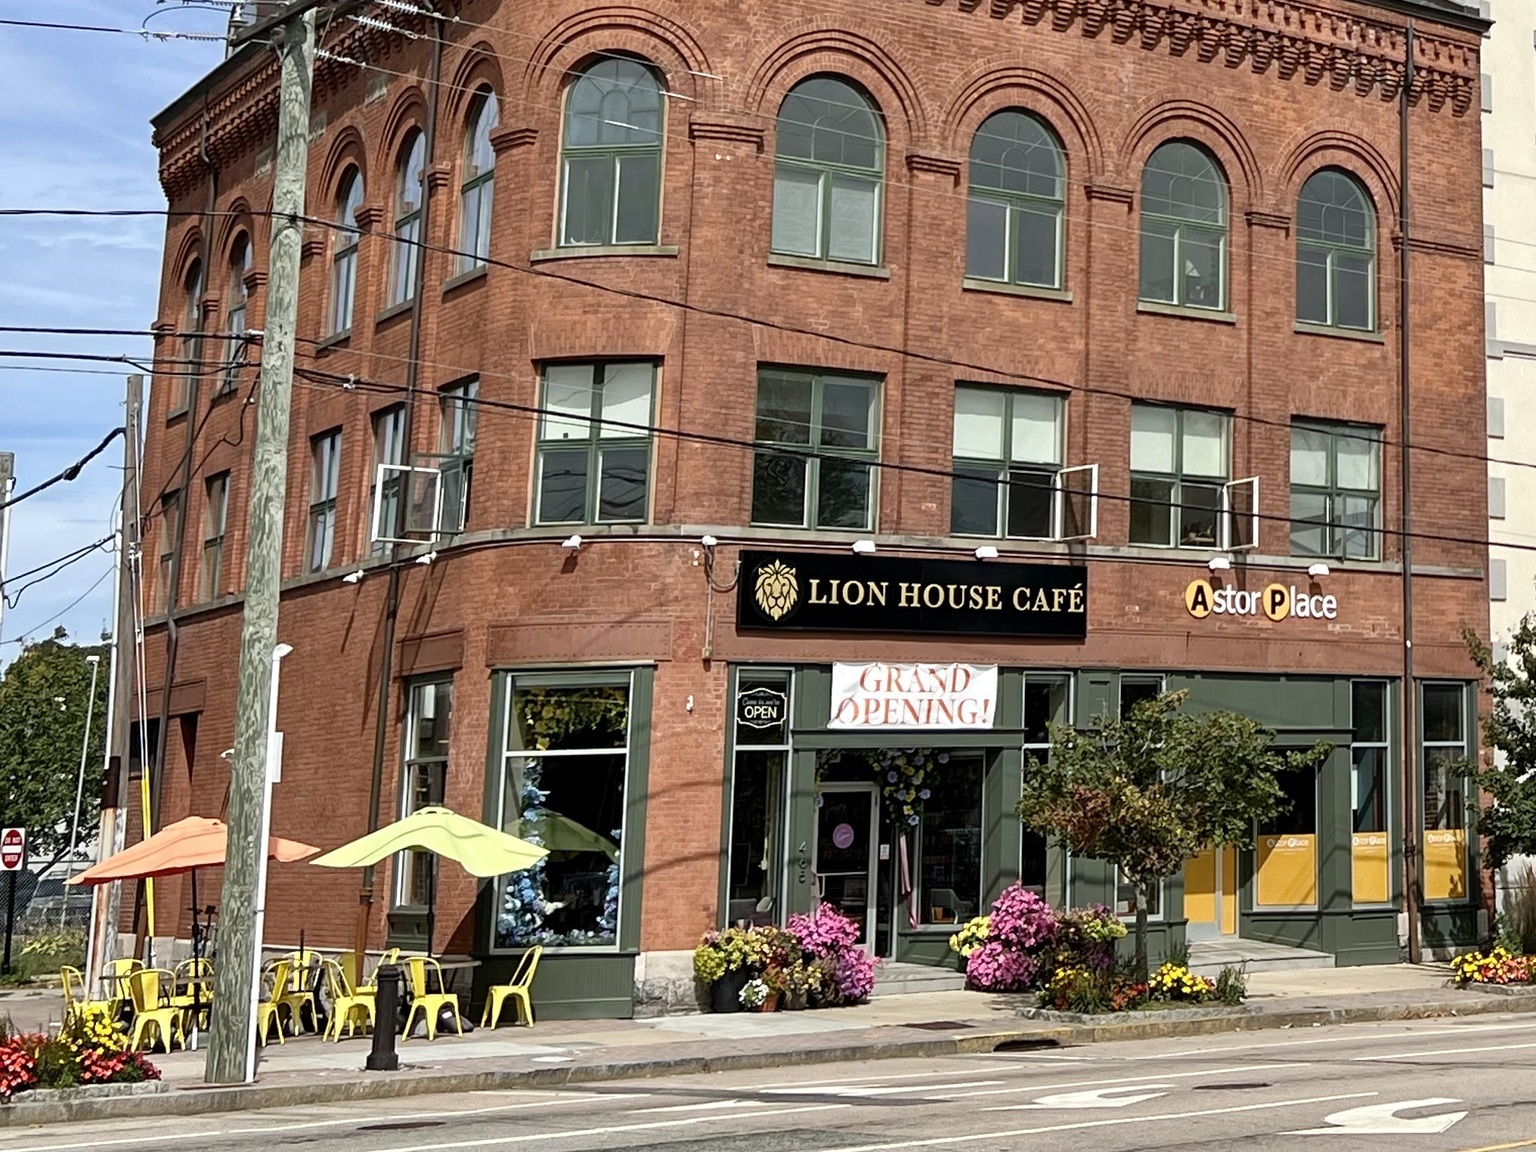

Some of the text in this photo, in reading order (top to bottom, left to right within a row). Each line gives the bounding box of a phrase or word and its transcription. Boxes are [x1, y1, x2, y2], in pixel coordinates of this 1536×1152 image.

[808, 579, 1084, 613] LION HOUSE CAFÉ
[1189, 582, 1337, 620] Astor Place
[859, 665, 971, 693] GRAND
[744, 705, 777, 719] OPEN
[835, 697, 990, 725] OPENING!
